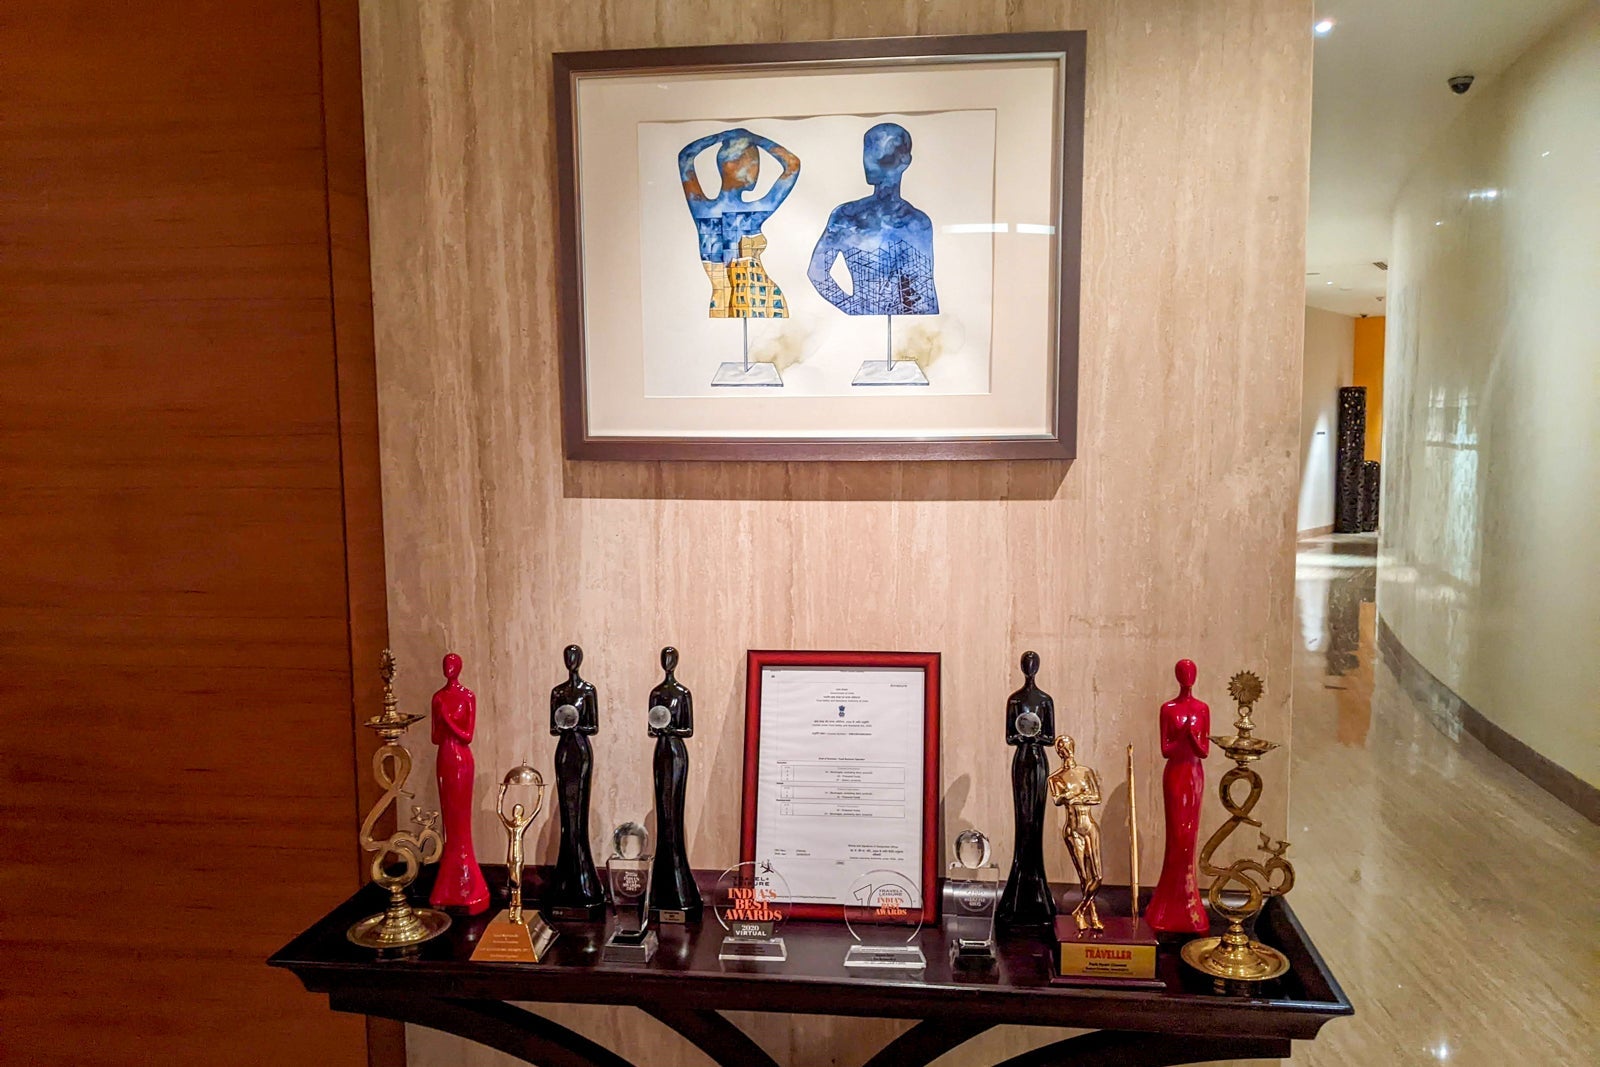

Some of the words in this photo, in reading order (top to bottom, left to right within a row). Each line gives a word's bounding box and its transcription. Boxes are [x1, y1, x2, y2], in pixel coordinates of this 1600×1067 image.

[728, 887, 777, 899] INDIA'S
[735, 899, 769, 910] BEST
[725, 910, 782, 921] AWARDS
[1085, 949, 1132, 960] TRAVELLER
